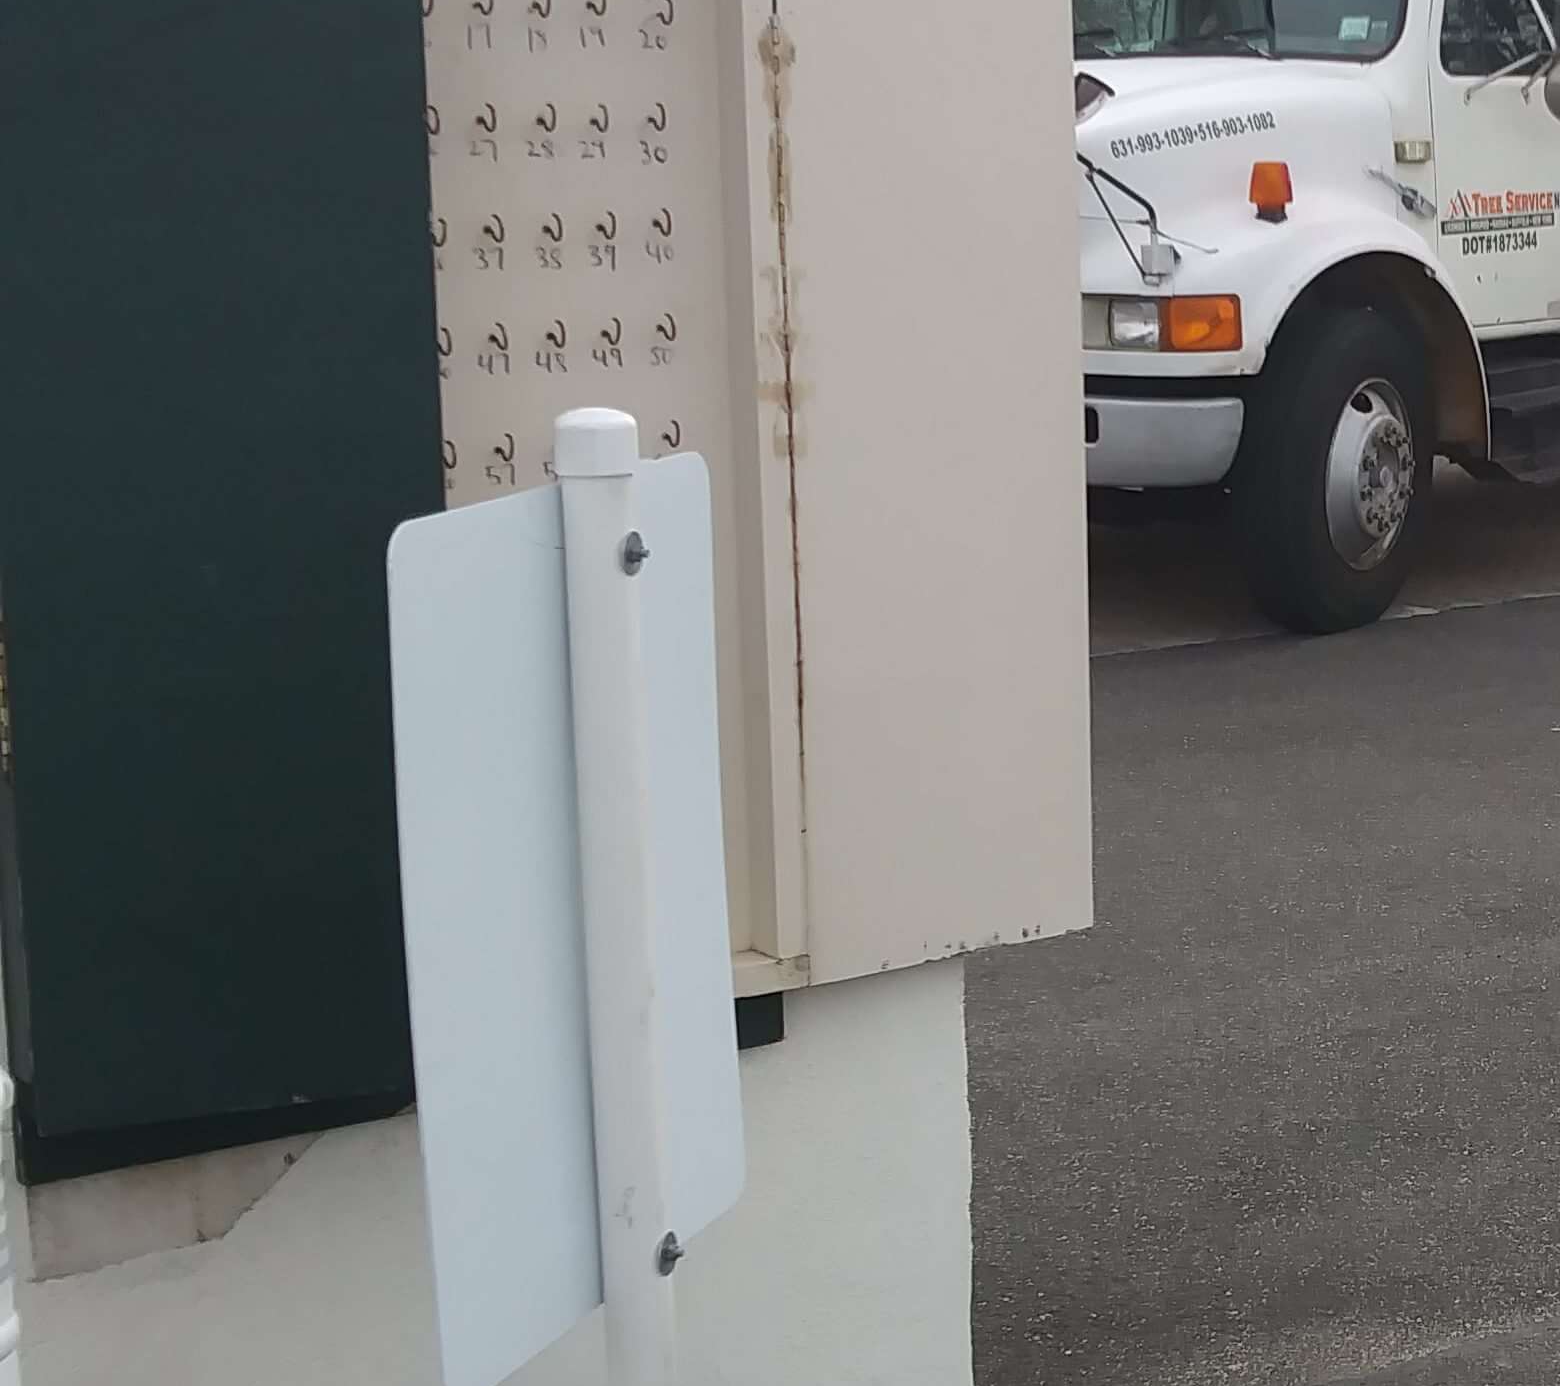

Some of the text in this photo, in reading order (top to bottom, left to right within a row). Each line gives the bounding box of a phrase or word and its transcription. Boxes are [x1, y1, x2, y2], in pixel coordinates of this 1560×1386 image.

[638, 29, 667, 50] 20
[469, 139, 498, 163] 27
[640, 140, 668, 164] 30
[1462, 230, 1538, 255] DOT#1873344
[472, 247, 504, 271] 37
[588, 245, 616, 272] 39
[646, 241, 674, 264] 40
[478, 354, 510, 374] 47
[592, 348, 623, 368] 49
[485, 462, 560, 485] 57 5
